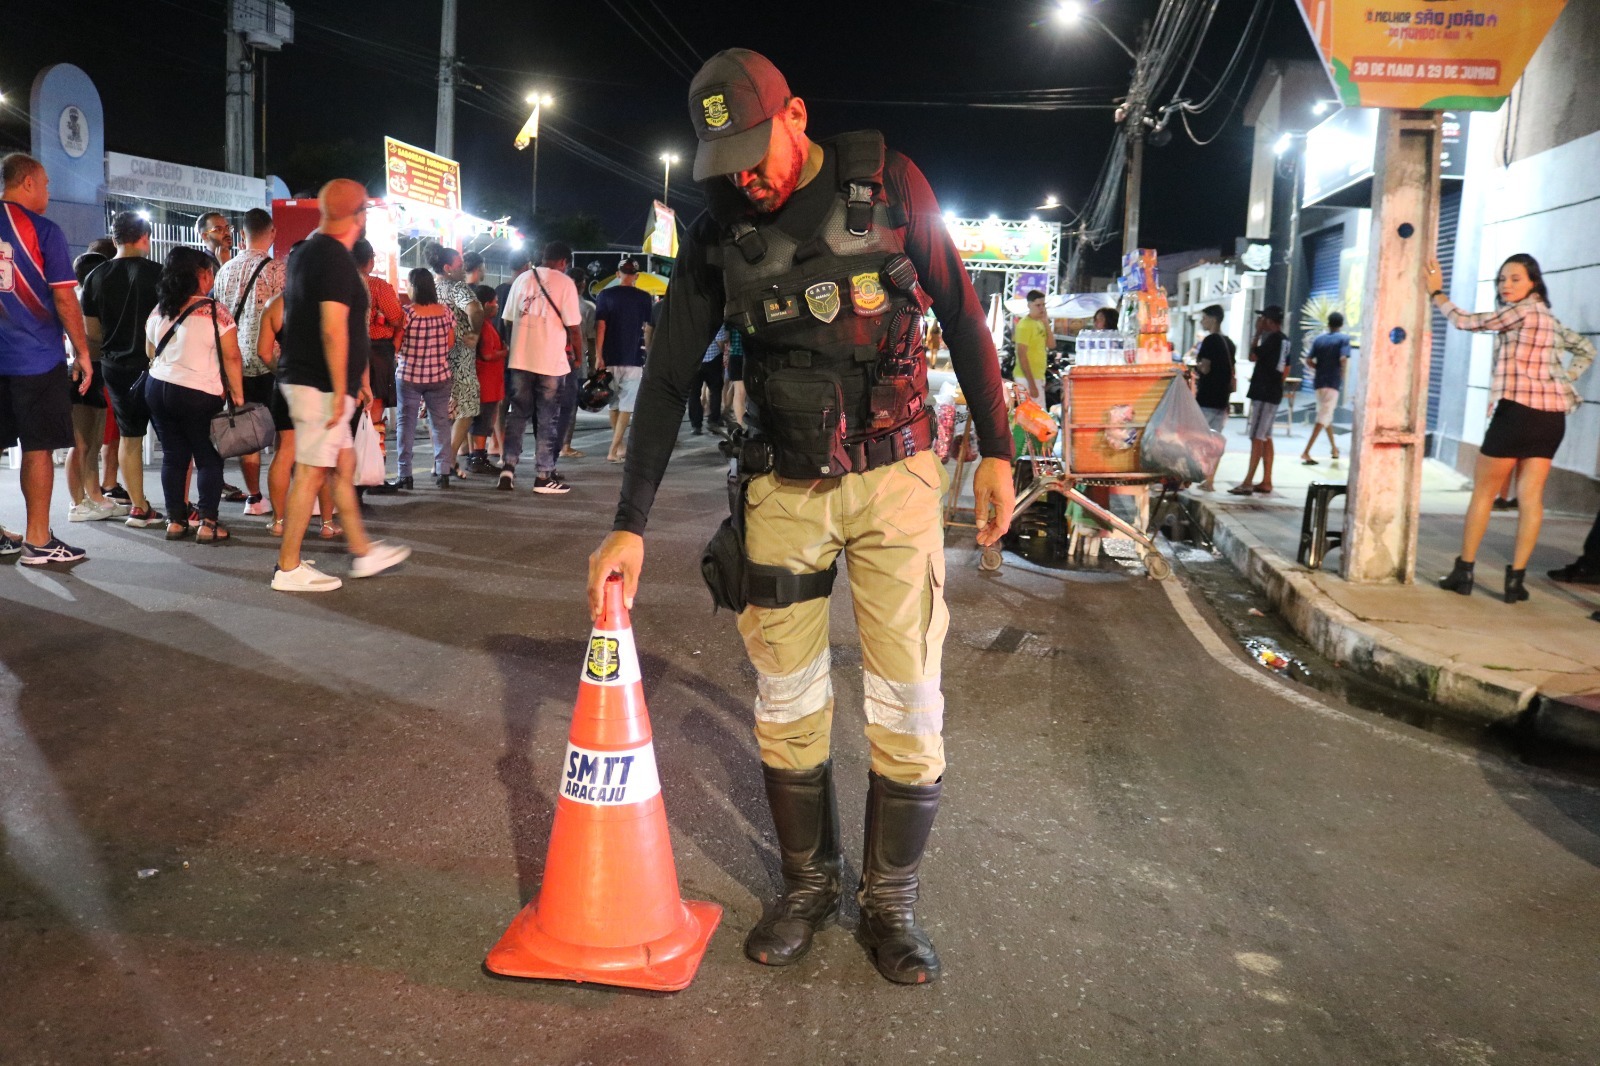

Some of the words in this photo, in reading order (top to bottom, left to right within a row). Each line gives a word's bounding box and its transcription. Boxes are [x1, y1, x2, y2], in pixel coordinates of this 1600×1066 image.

[1375, 11, 1411, 23] MELHOR
[1415, 8, 1445, 25] SÃO
[1445, 9, 1485, 29] JOÃO
[1400, 27, 1436, 40] MUNDO
[1353, 62, 1369, 76] 30
[1370, 62, 1385, 76] DE
[1386, 63, 1415, 78] MAIO
[1416, 64, 1426, 78] A
[1427, 64, 1442, 79] 29
[1443, 65, 1459, 79] DE
[1460, 65, 1496, 80] JUNHO
[130, 158, 183, 182] COLÉGIO
[193, 169, 248, 191] ESTADUAL
[809, 285, 832, 295] GART
[566, 750, 635, 786] SMTT
[564, 780, 627, 803] ARACAJU
